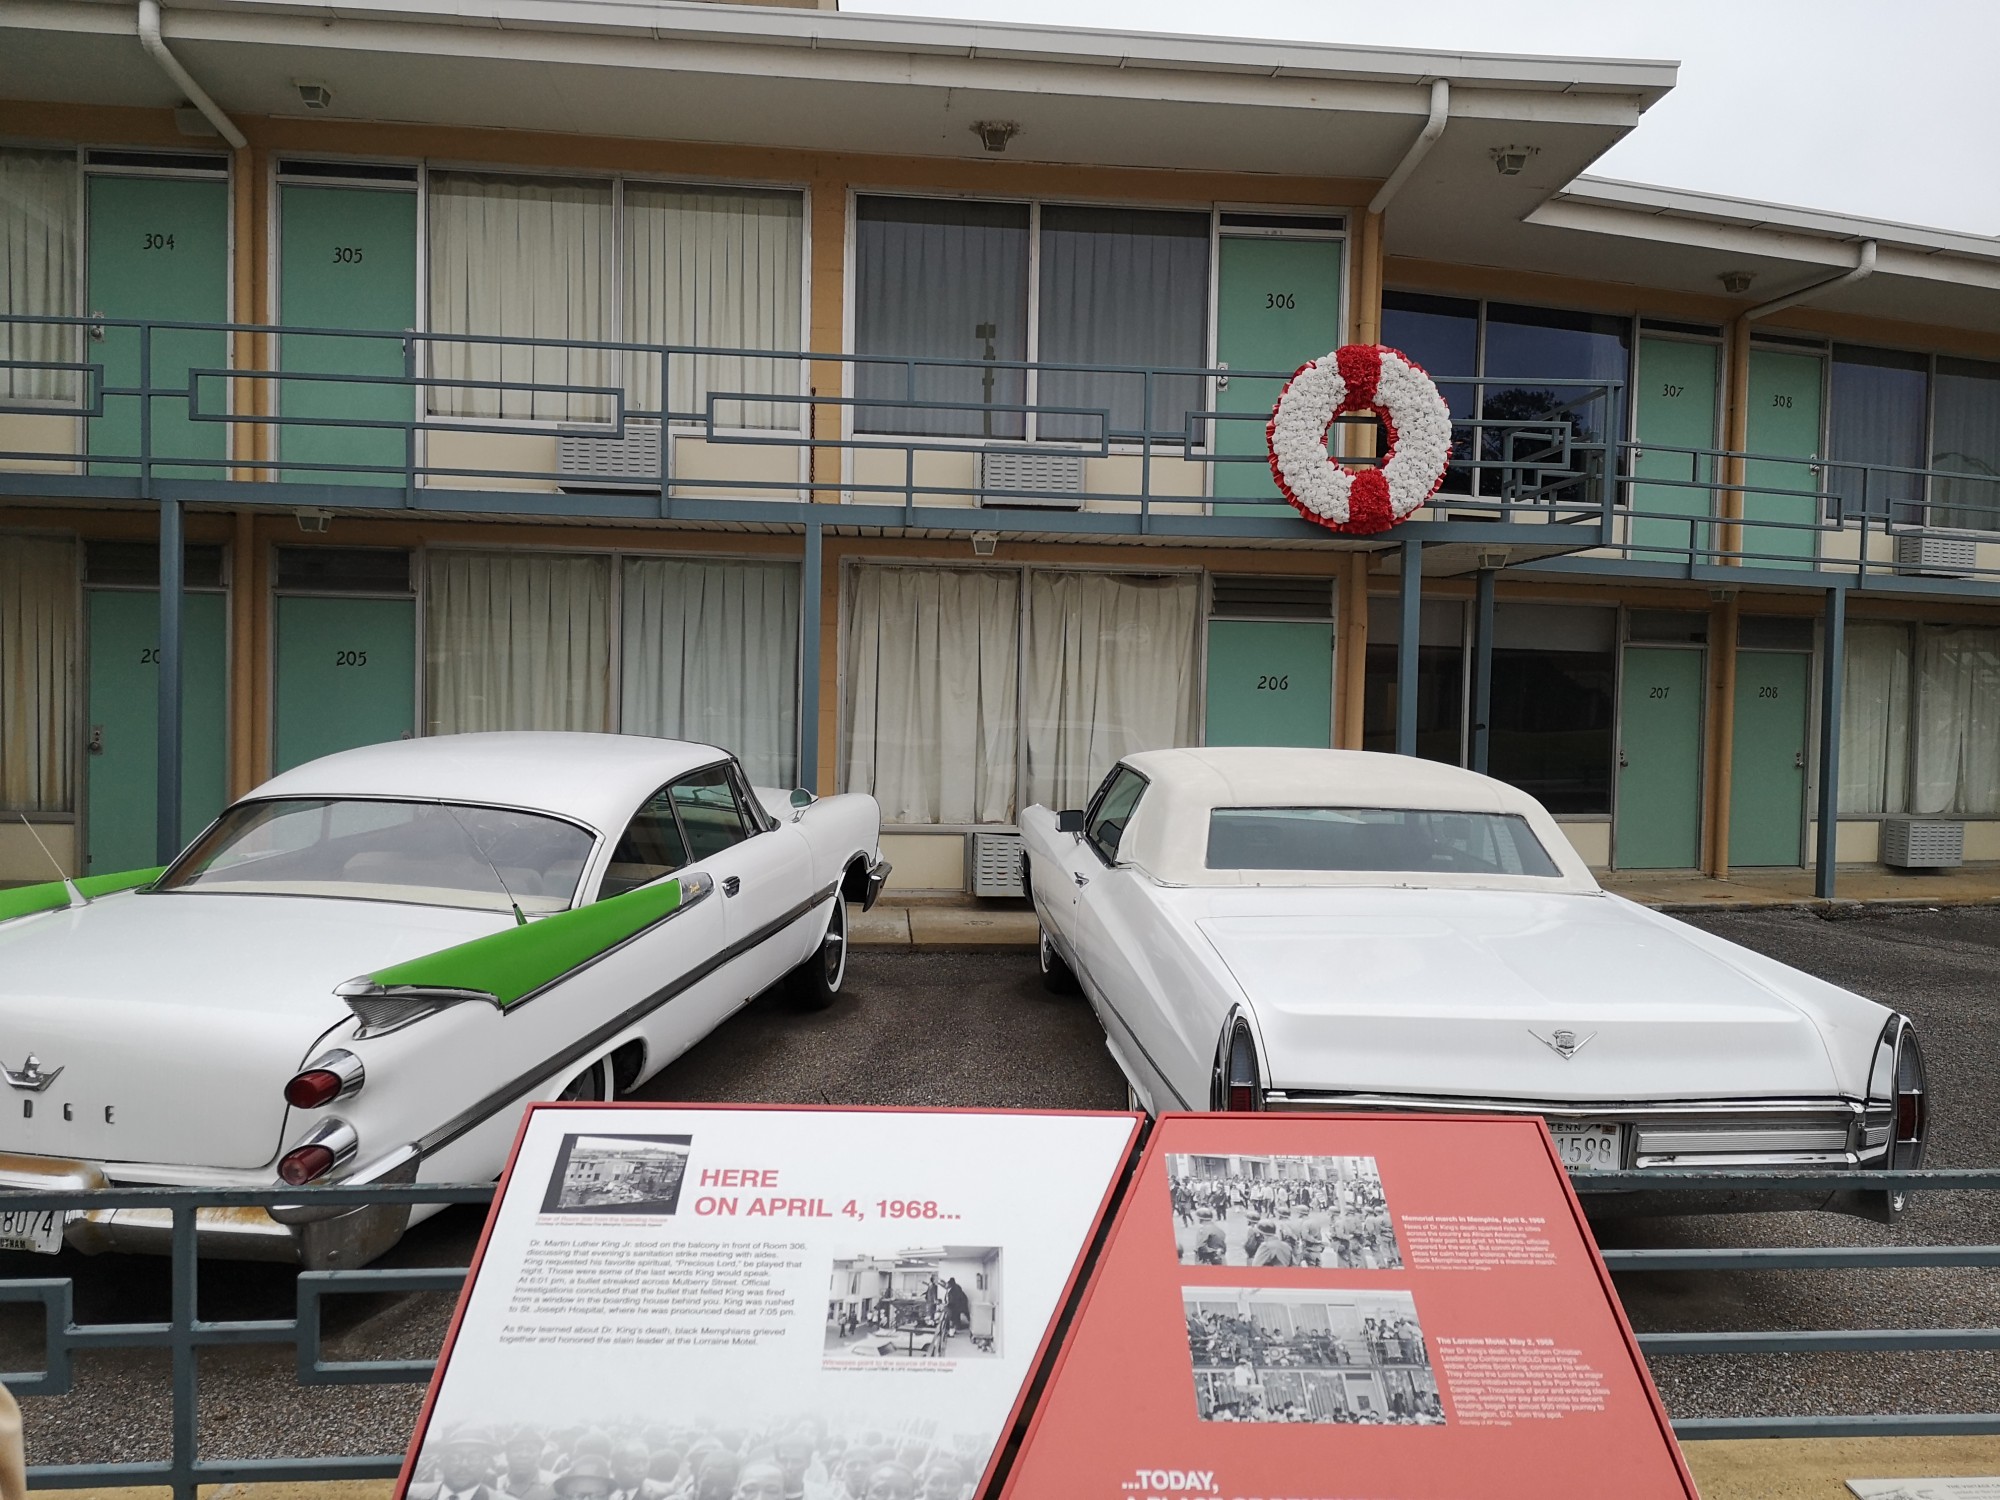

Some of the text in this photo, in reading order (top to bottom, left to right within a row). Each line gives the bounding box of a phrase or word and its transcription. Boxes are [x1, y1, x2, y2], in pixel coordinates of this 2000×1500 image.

[143, 233, 175, 251] 304
[332, 246, 363, 264] 305
[1265, 293, 1296, 310] 306
[1662, 383, 1684, 398] 307
[1772, 394, 1793, 409] 308
[140, 648, 160, 665] 20
[336, 650, 367, 667] 205
[1256, 675, 1289, 691] 206
[1649, 686, 1670, 699] 207
[1758, 686, 1778, 699] 208
[1557, 1138, 1611, 1163] 1598
[700, 1169, 779, 1188] HERE
[694, 1197, 961, 1221] ON APRIL 4, 1968...
[526, 1249, 571, 1257] discussing
[700, 1251, 733, 1259] meeting
[672, 1279, 709, 1287] Mulberry
[515, 1286, 574, 1294] investigations
[725, 1289, 744, 1297] King
[603, 1297, 641, 1306] boarding
[724, 1298, 742, 1306] King
[516, 1326, 537, 1334] they
[616, 1327, 643, 1336] King's
[701, 1328, 751, 1336] Memphians
[500, 1336, 537, 1344] together
[1121, 1470, 1219, 1494] ...TODAY,
